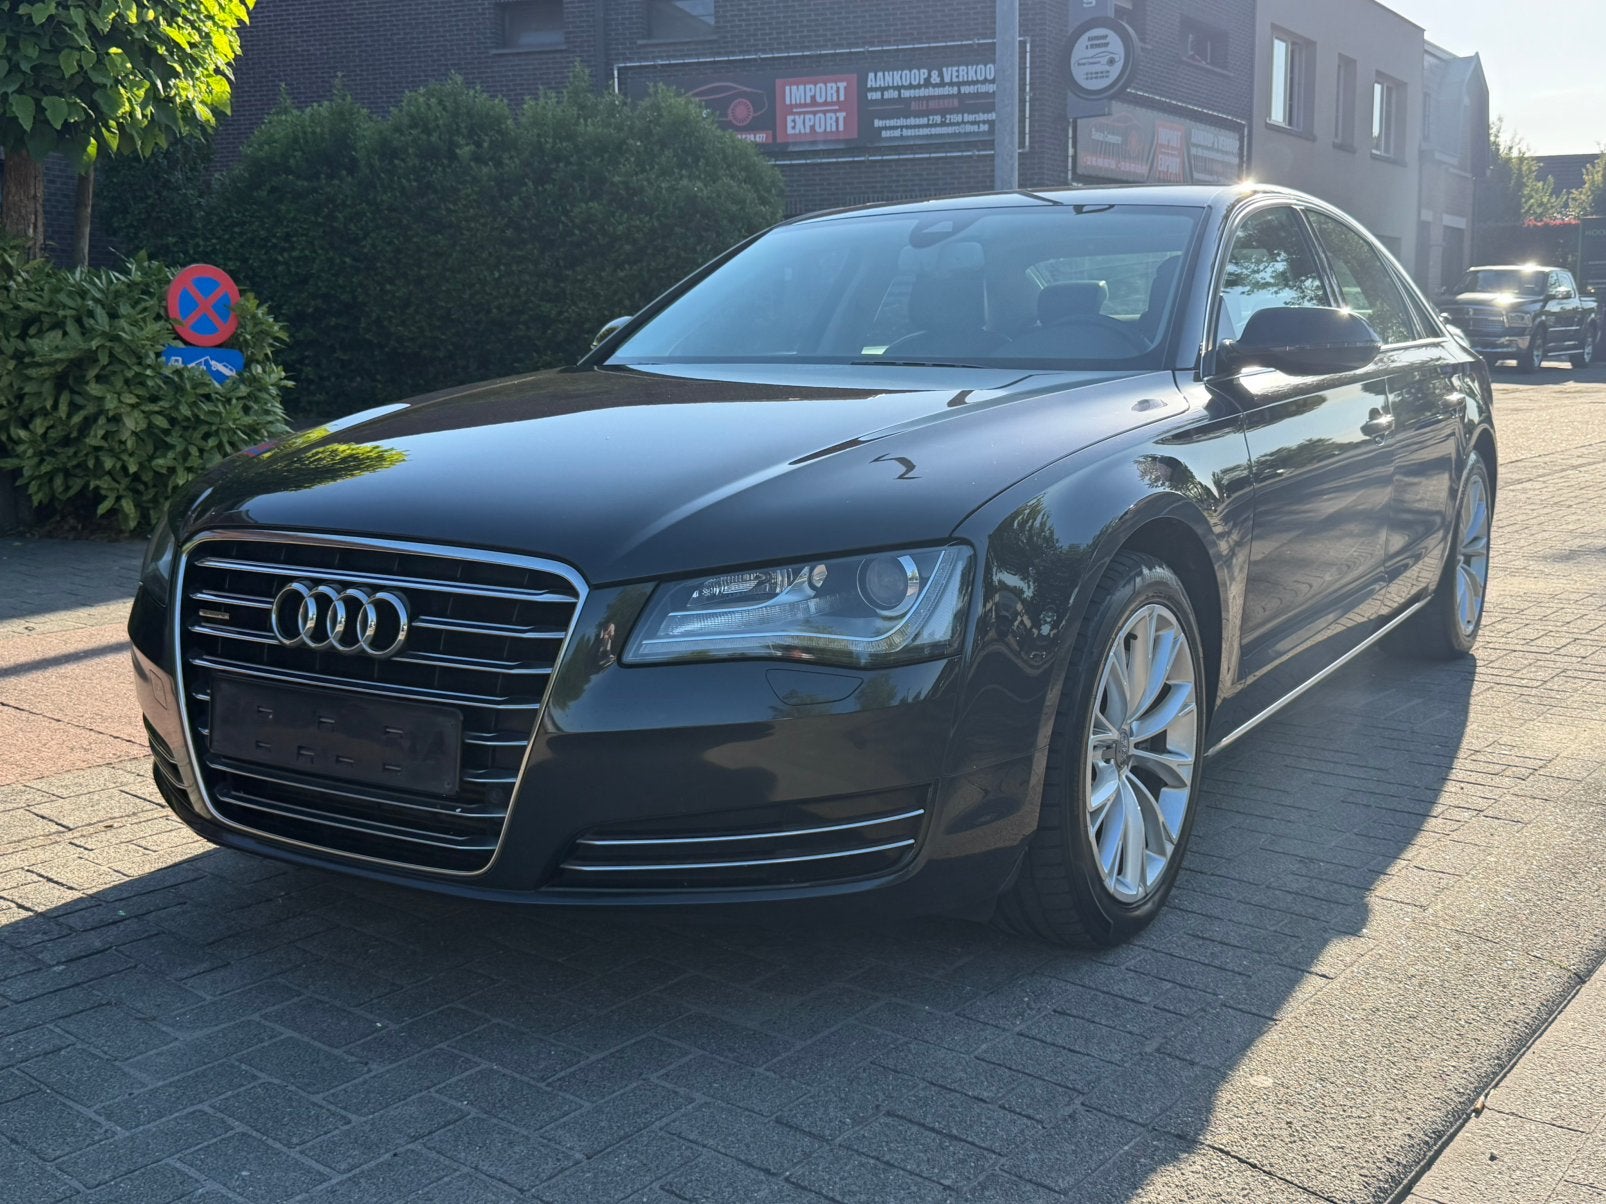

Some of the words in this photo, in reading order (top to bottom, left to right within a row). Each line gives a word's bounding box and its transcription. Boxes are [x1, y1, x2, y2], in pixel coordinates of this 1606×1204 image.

[867, 68, 928, 88] AANKOOP
[930, 70, 940, 83] &
[942, 63, 995, 83] VERKOO
[785, 82, 847, 105] IMPORT
[867, 90, 881, 100] van
[883, 89, 899, 99] alle
[900, 85, 958, 98] tweedehandse
[786, 112, 847, 134] EXPORT
[928, 115, 941, 124] 279
